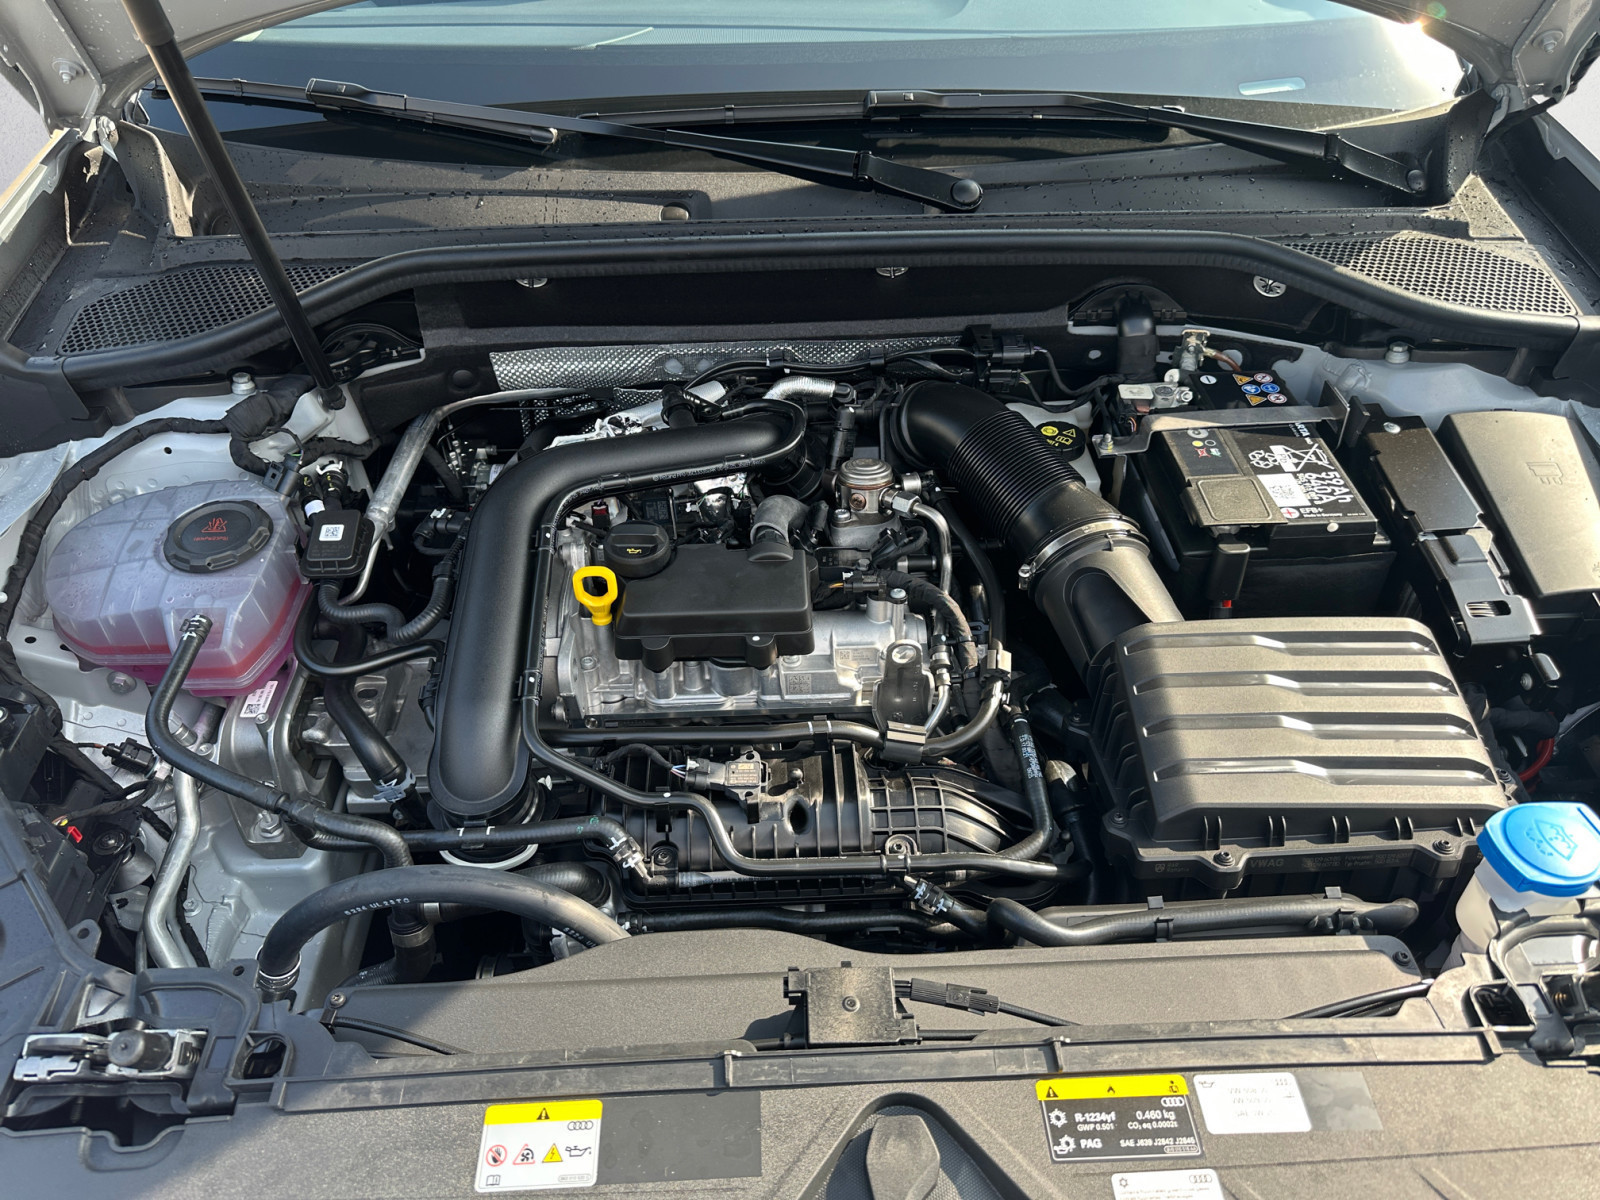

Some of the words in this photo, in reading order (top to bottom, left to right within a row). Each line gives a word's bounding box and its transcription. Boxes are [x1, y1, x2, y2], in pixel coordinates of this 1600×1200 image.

[1306, 472, 1337, 505] 640A
[1321, 471, 1354, 503] 59Ah
[1299, 507, 1324, 515] EFB+
[1074, 1111, 1116, 1123] R-1234yf
[1162, 1109, 1176, 1121] kg
[1077, 1123, 1095, 1131] GWP
[1095, 1122, 1114, 1131] 0.501
[1080, 1138, 1103, 1149] PAG
[1120, 1139, 1135, 1148] SAE
[1136, 1138, 1153, 1147] J639
